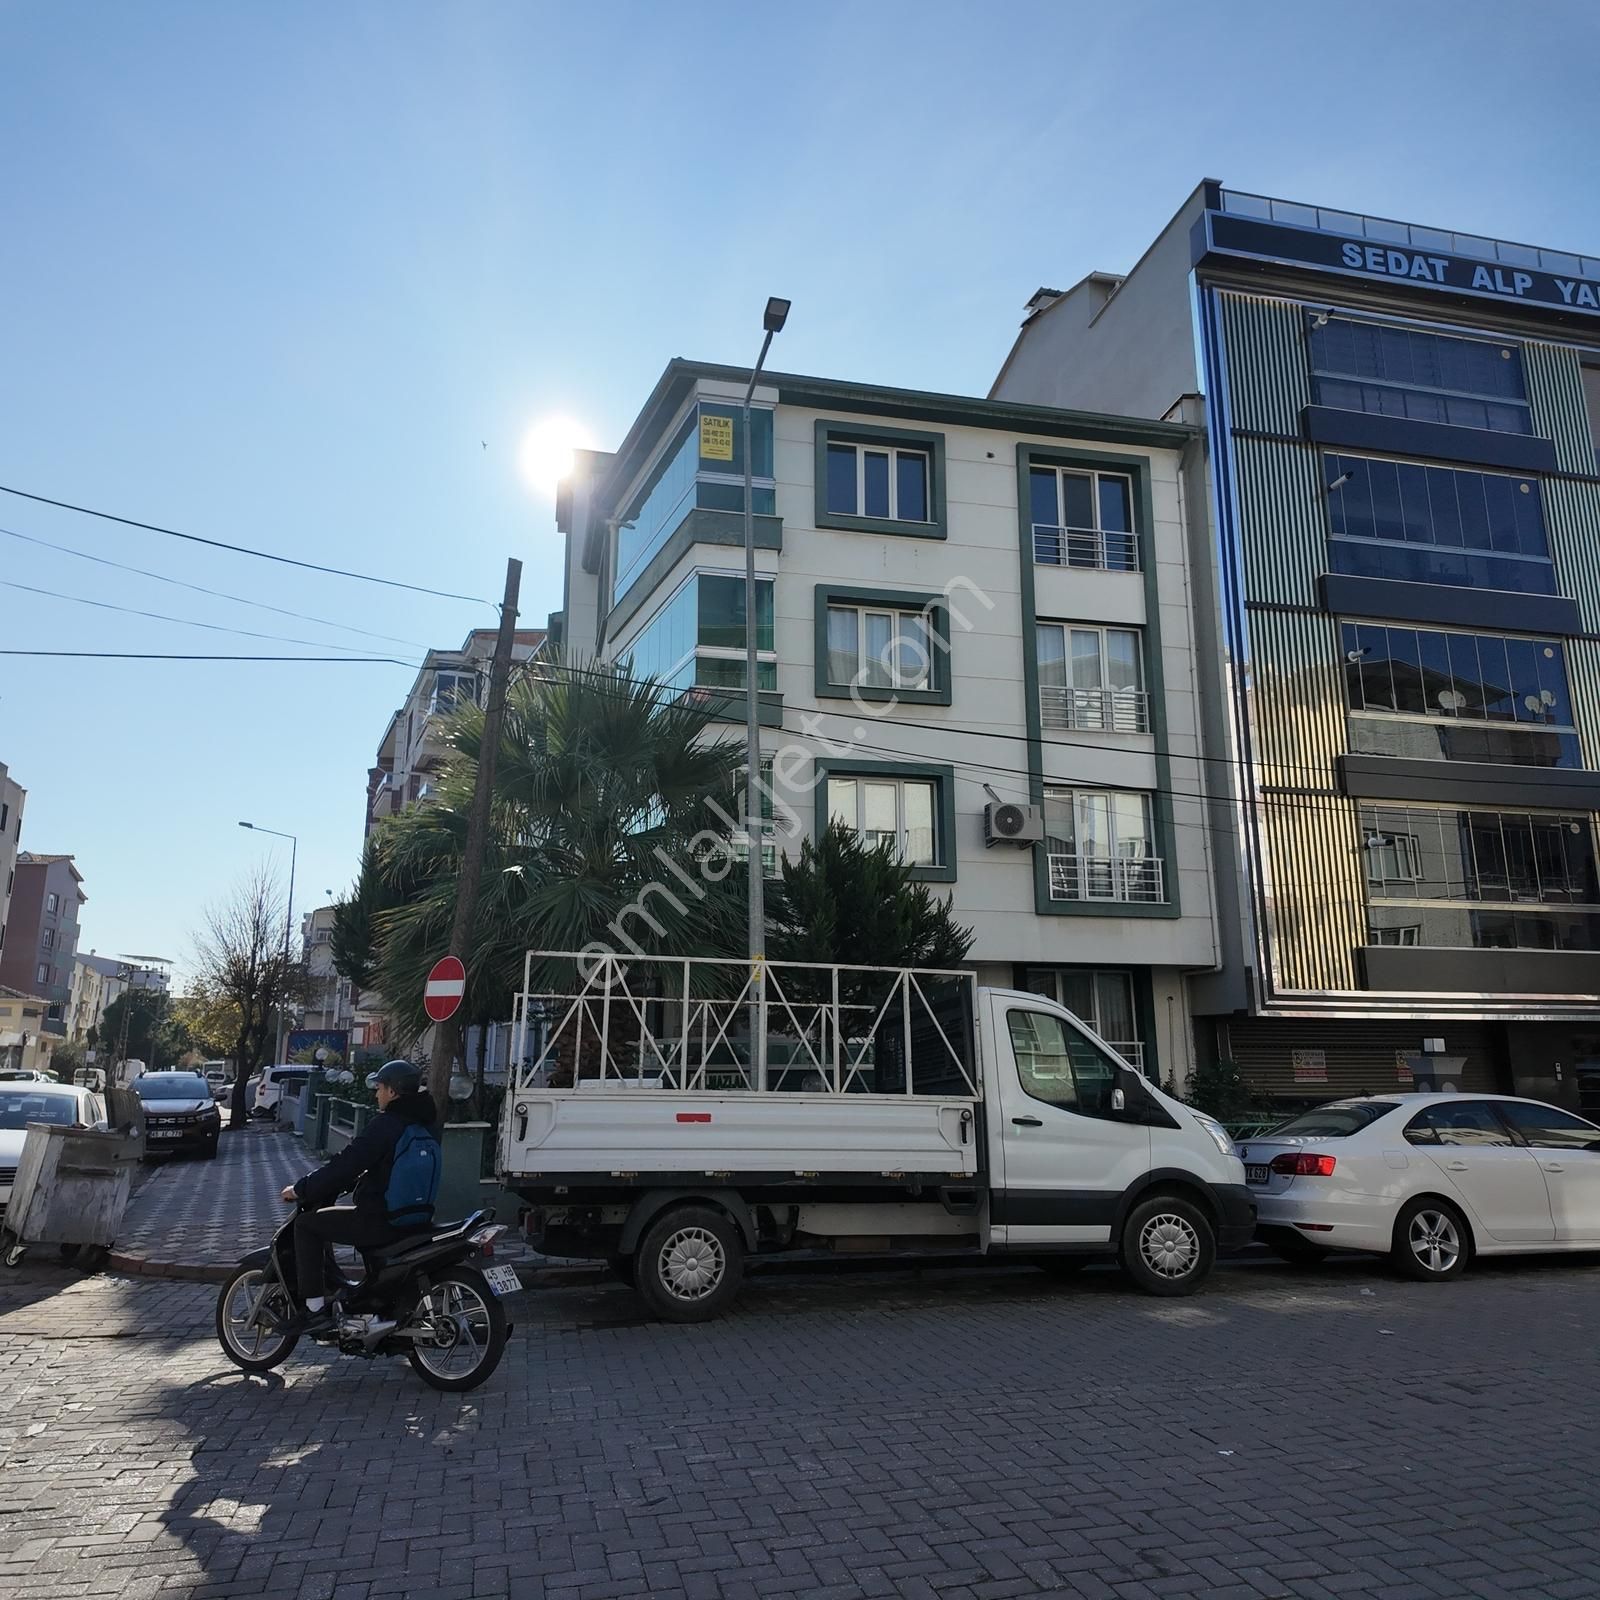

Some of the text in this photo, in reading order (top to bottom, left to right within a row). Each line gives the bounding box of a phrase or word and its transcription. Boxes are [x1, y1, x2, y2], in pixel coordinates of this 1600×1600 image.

[1341, 242, 1600, 309] SEDAT ALP YA
[703, 417, 730, 428] SATILIK
[486, 1269, 499, 1280] 45
[497, 1278, 518, 1292] 3877
